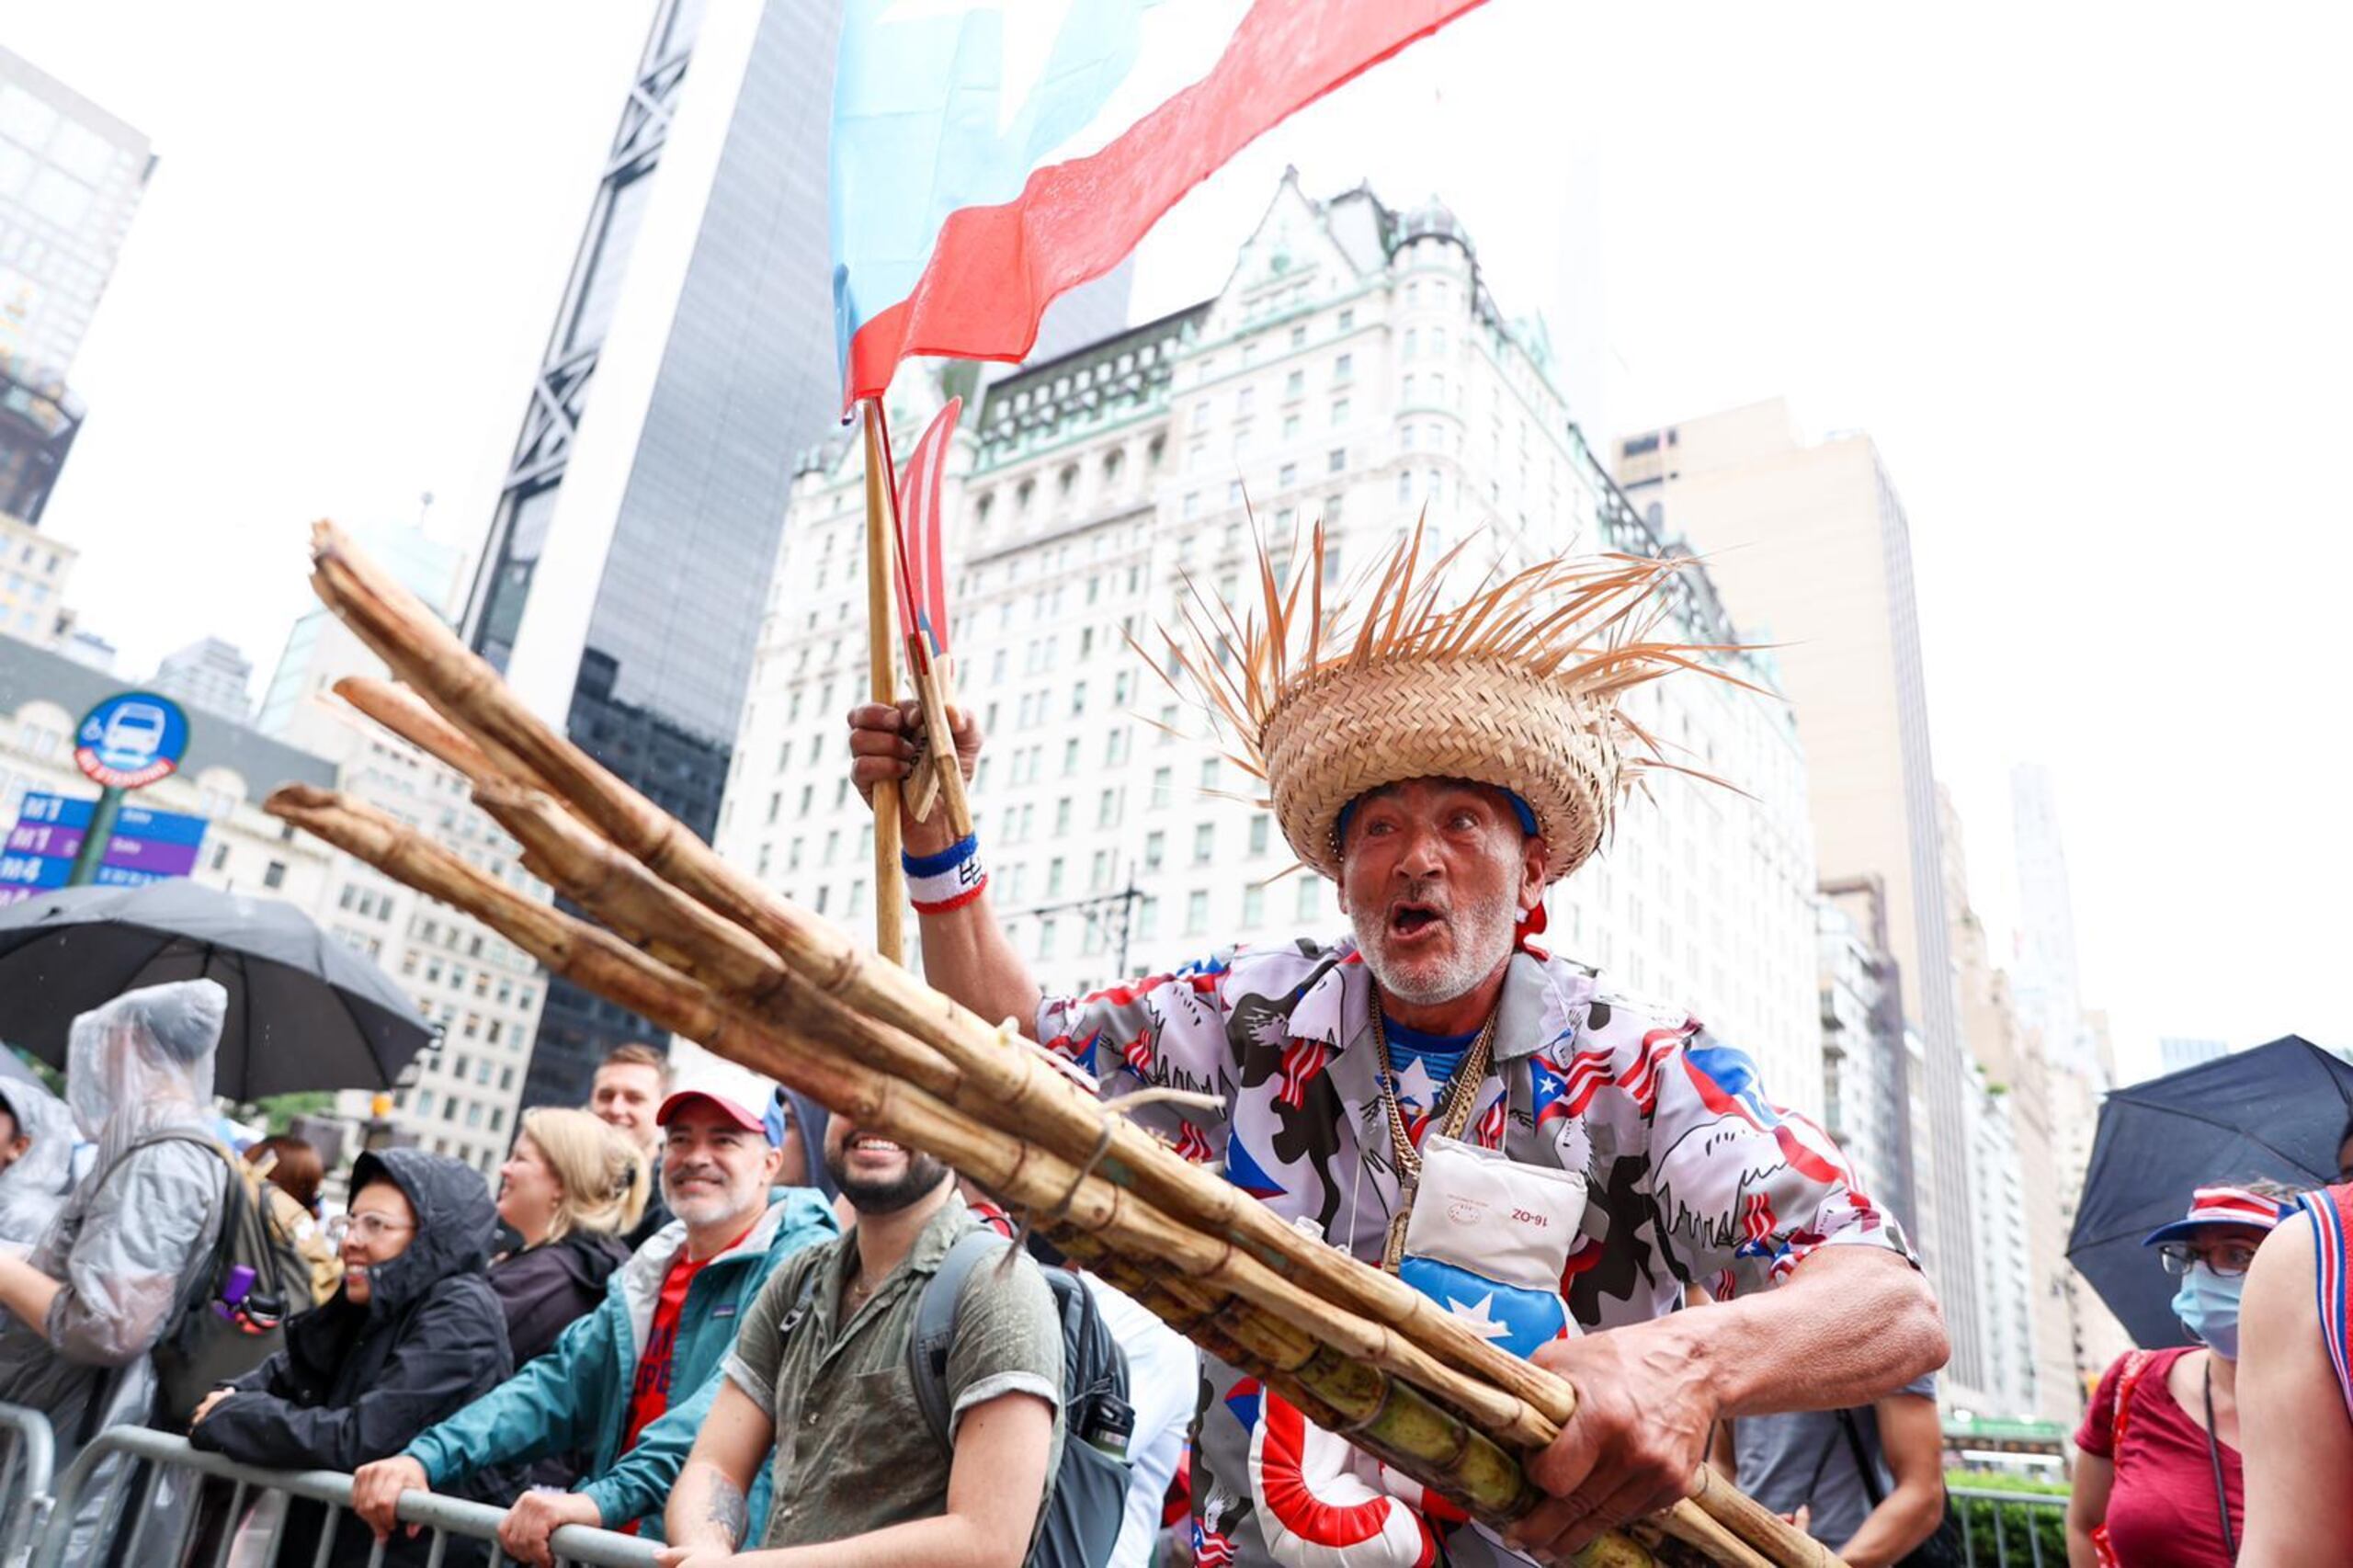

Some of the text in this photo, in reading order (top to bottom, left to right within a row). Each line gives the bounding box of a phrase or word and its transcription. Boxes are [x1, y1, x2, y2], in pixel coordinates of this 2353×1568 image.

[23, 796, 63, 821] M1
[10, 826, 51, 852] M1
[0, 856, 43, 883] M4
[1512, 1208, 1548, 1227] 16-OZ
